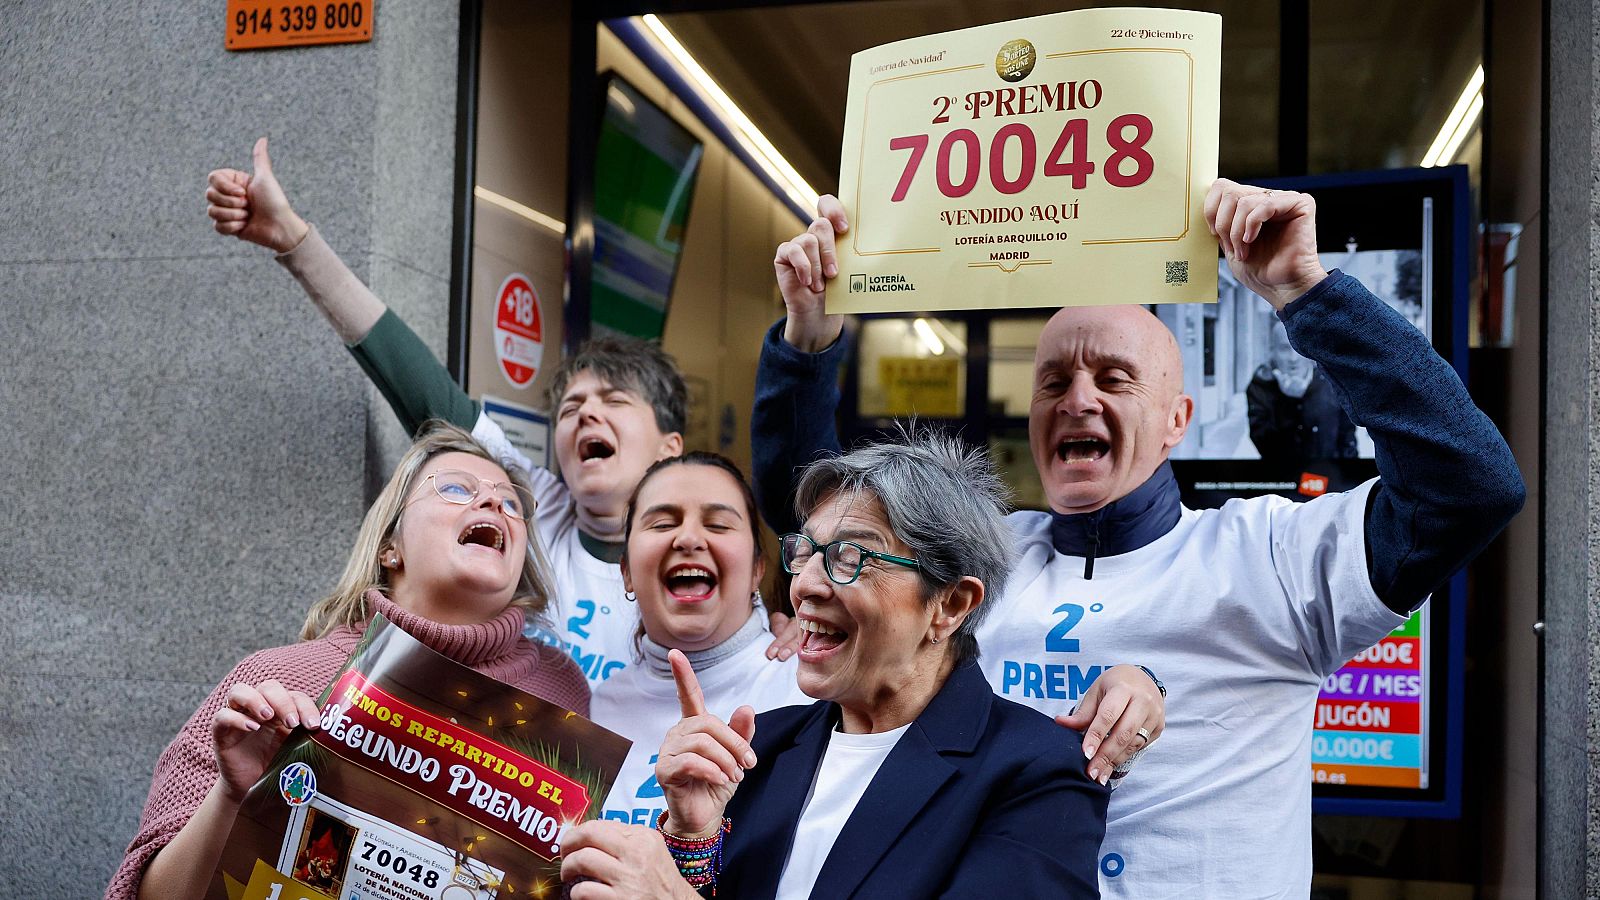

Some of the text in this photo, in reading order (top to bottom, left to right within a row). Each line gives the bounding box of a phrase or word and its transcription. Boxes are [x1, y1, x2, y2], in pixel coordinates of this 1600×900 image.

[236, 2, 362, 35] 914 339 800
[1111, 28, 1194, 41] 22 de Diciembre
[897, 59, 908, 68] de
[964, 79, 1103, 120] PREMIO
[889, 113, 1154, 203] 70048
[940, 199, 1079, 226] VENDIDO AQUÍ
[955, 232, 1068, 246] LOTERÍA BARQUILLO 10
[989, 251, 1030, 261] MADRID
[869, 274, 906, 284] LOTERÍA
[869, 283, 916, 293] NACIONAL
[504, 286, 534, 327] +18
[1002, 660, 1114, 700] PREM
[1357, 673, 1370, 695] /
[1373, 674, 1421, 697] MES
[1316, 702, 1391, 728] JUGÓN
[343, 684, 564, 806] HEMOS REPARTIDO EL
[320, 703, 571, 854] ¡SEGUNDO PREMIO!
[354, 863, 390, 885] LOTERÍA
[360, 841, 440, 889] 70048
[354, 881, 362, 890] 22
[362, 886, 371, 894] de
[365, 878, 416, 900] DE NAVIDA
